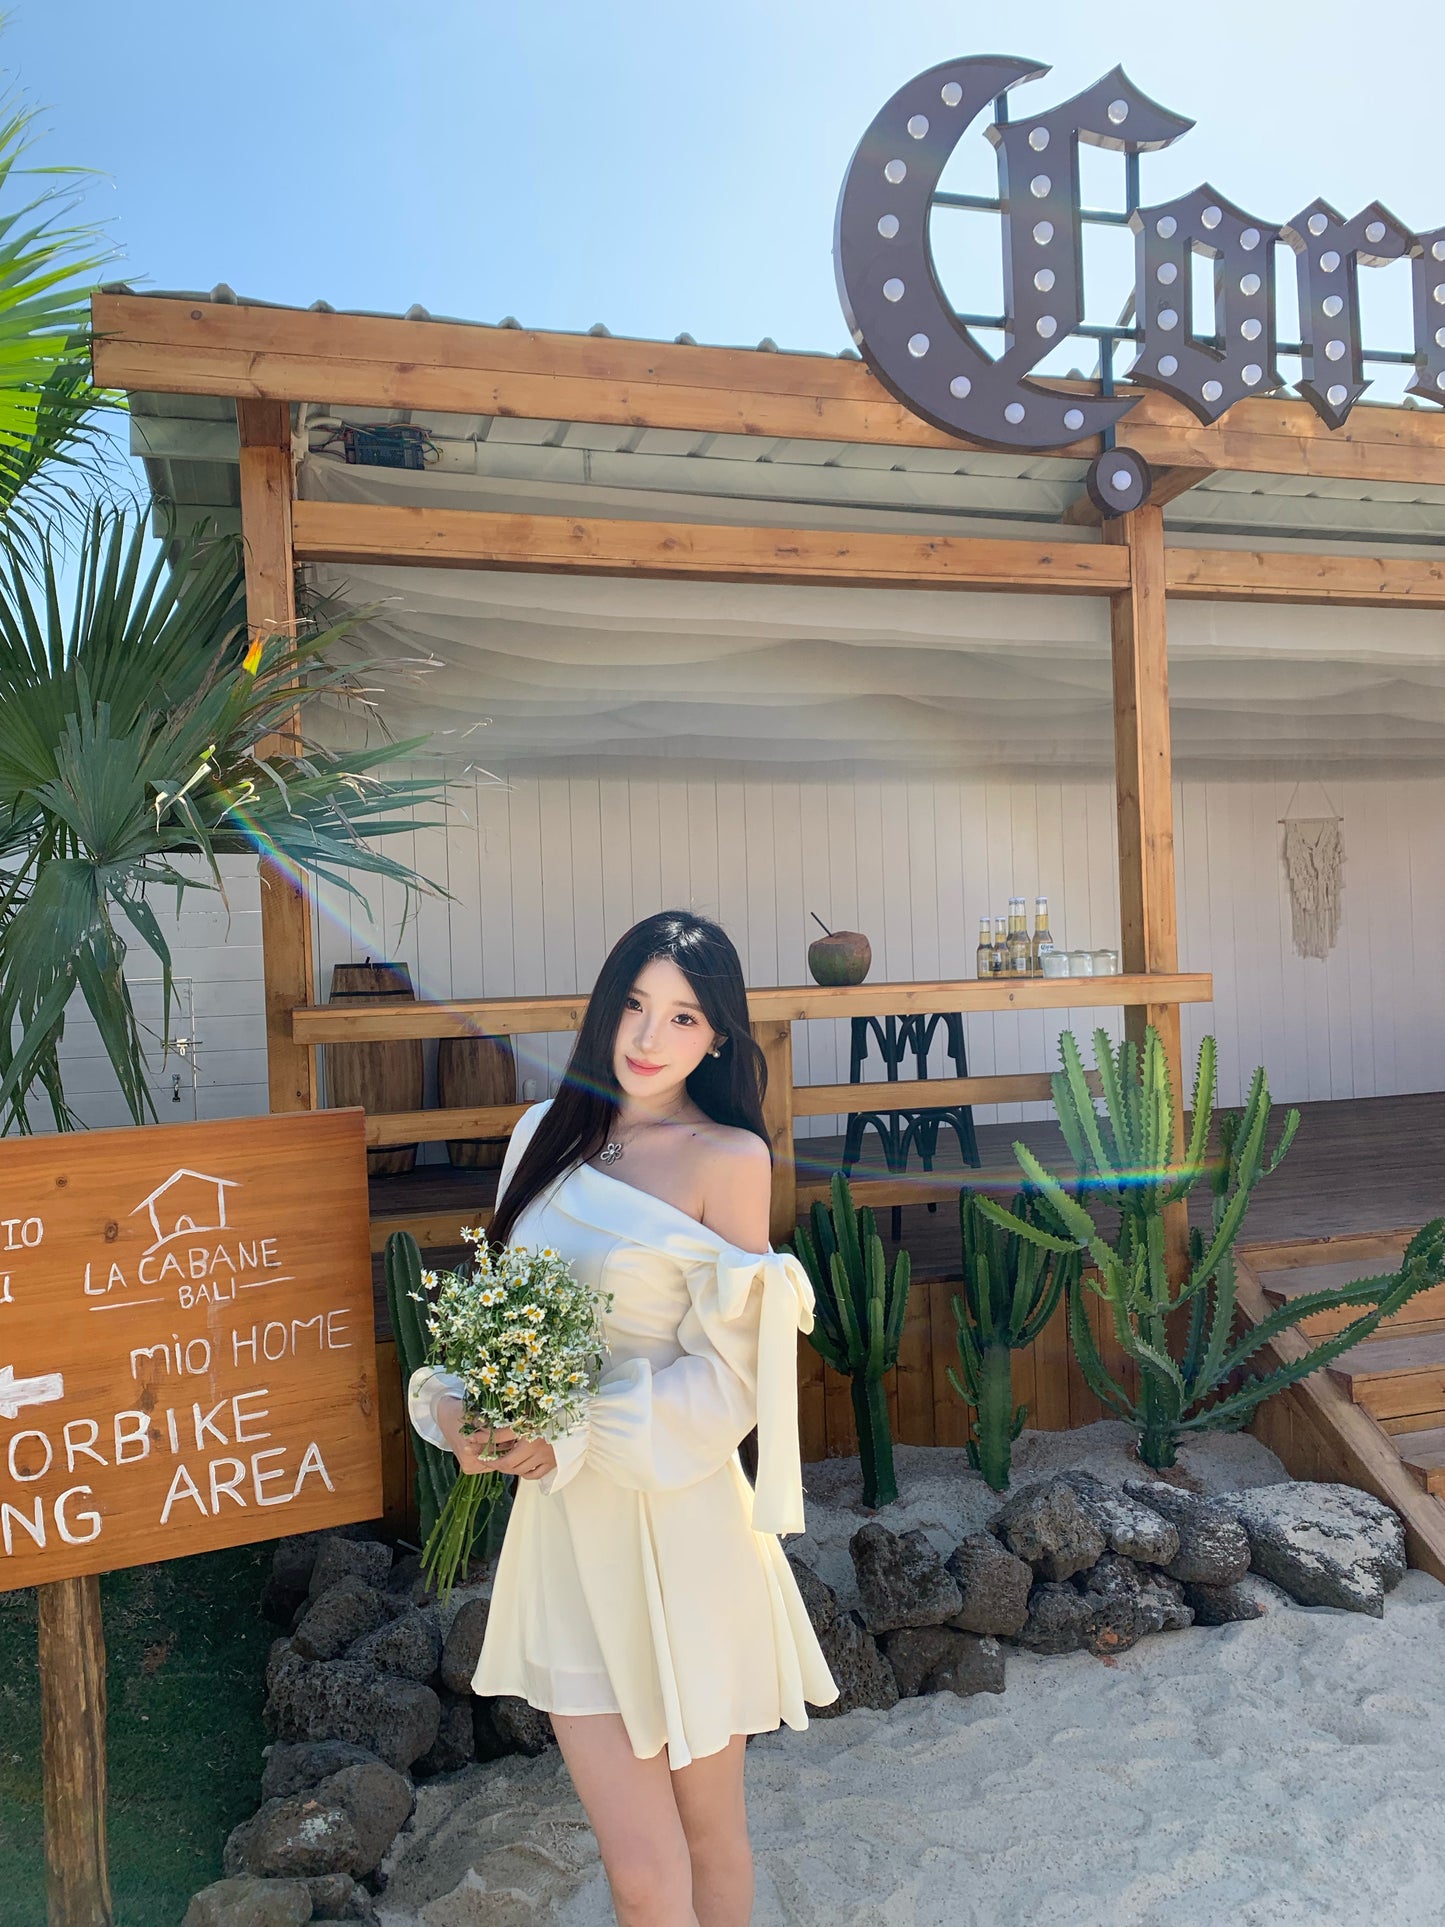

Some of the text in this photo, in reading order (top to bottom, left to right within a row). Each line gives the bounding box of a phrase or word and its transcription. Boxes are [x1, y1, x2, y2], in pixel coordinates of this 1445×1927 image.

[1, 1217, 44, 1251] IO
[84, 1238, 282, 1295] LA CABANE
[178, 1277, 236, 1309] BALI
[232, 1308, 353, 1367] HOME
[8, 1389, 271, 1482] ORBIKE
[0, 1441, 335, 1555] NG AREA
